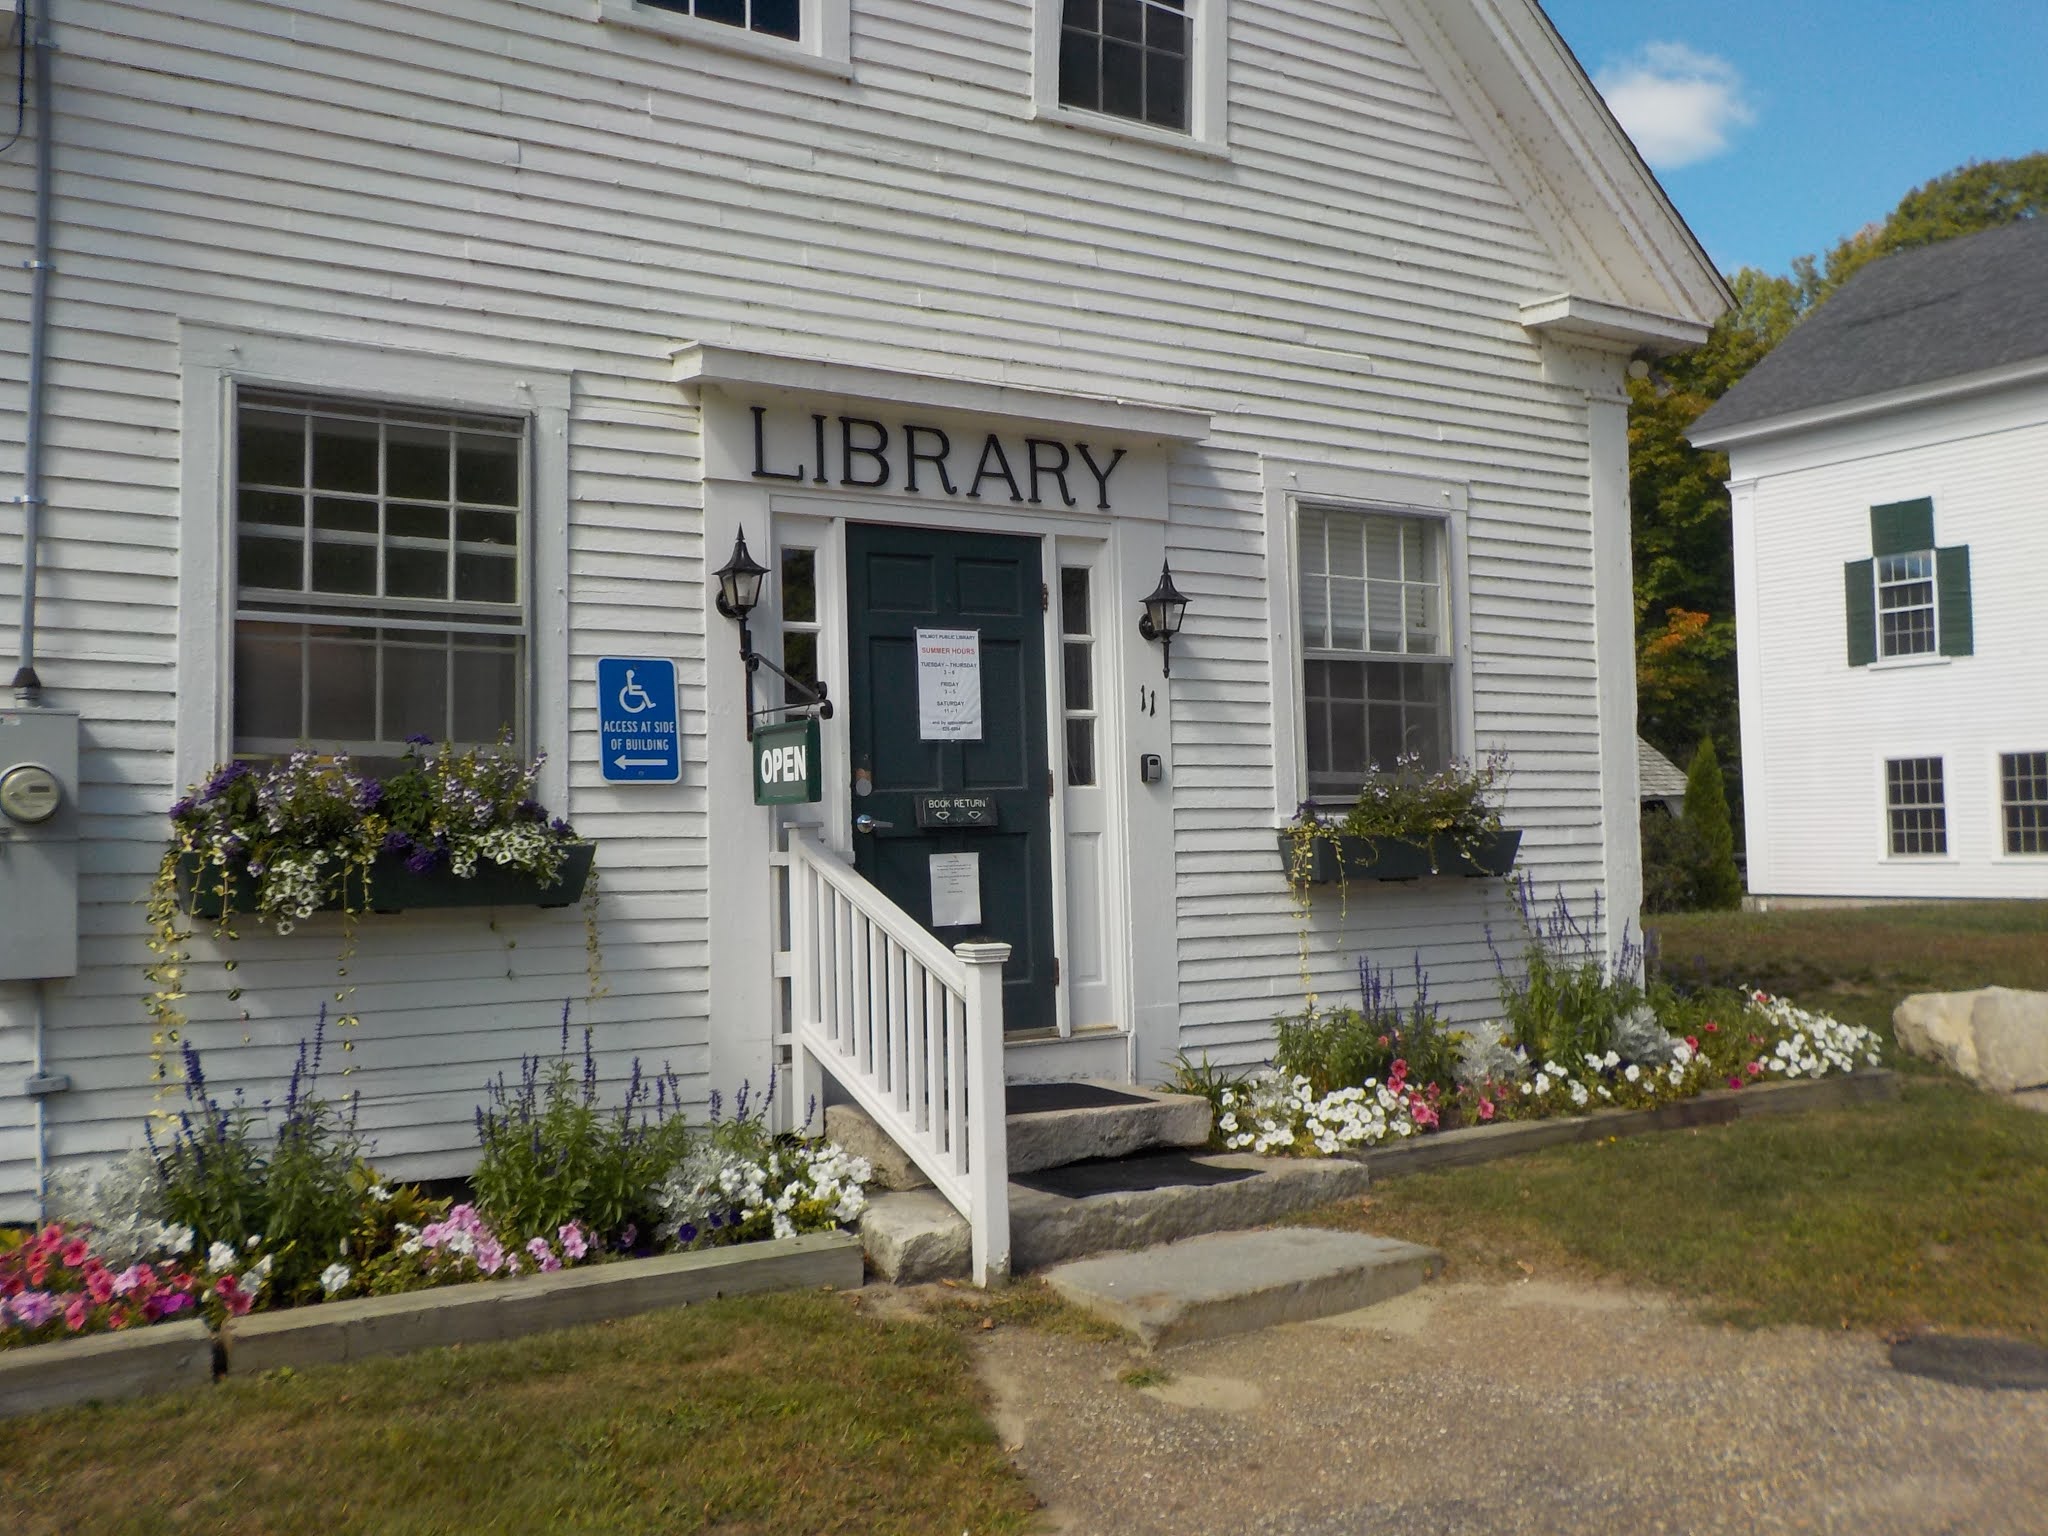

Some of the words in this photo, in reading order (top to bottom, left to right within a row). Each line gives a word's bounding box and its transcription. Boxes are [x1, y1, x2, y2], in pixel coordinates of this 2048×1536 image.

[751, 406, 1127, 509] LIBRARY
[1140, 684, 1155, 717] 11
[603, 720, 638, 733] ACCESS
[640, 721, 652, 733] AT
[654, 721, 675, 733] SIDE
[611, 738, 623, 750] OF
[626, 738, 669, 751] BUILDING
[761, 745, 807, 783] OPEN
[928, 799, 951, 808] BOOK
[954, 798, 986, 808] RETURN
